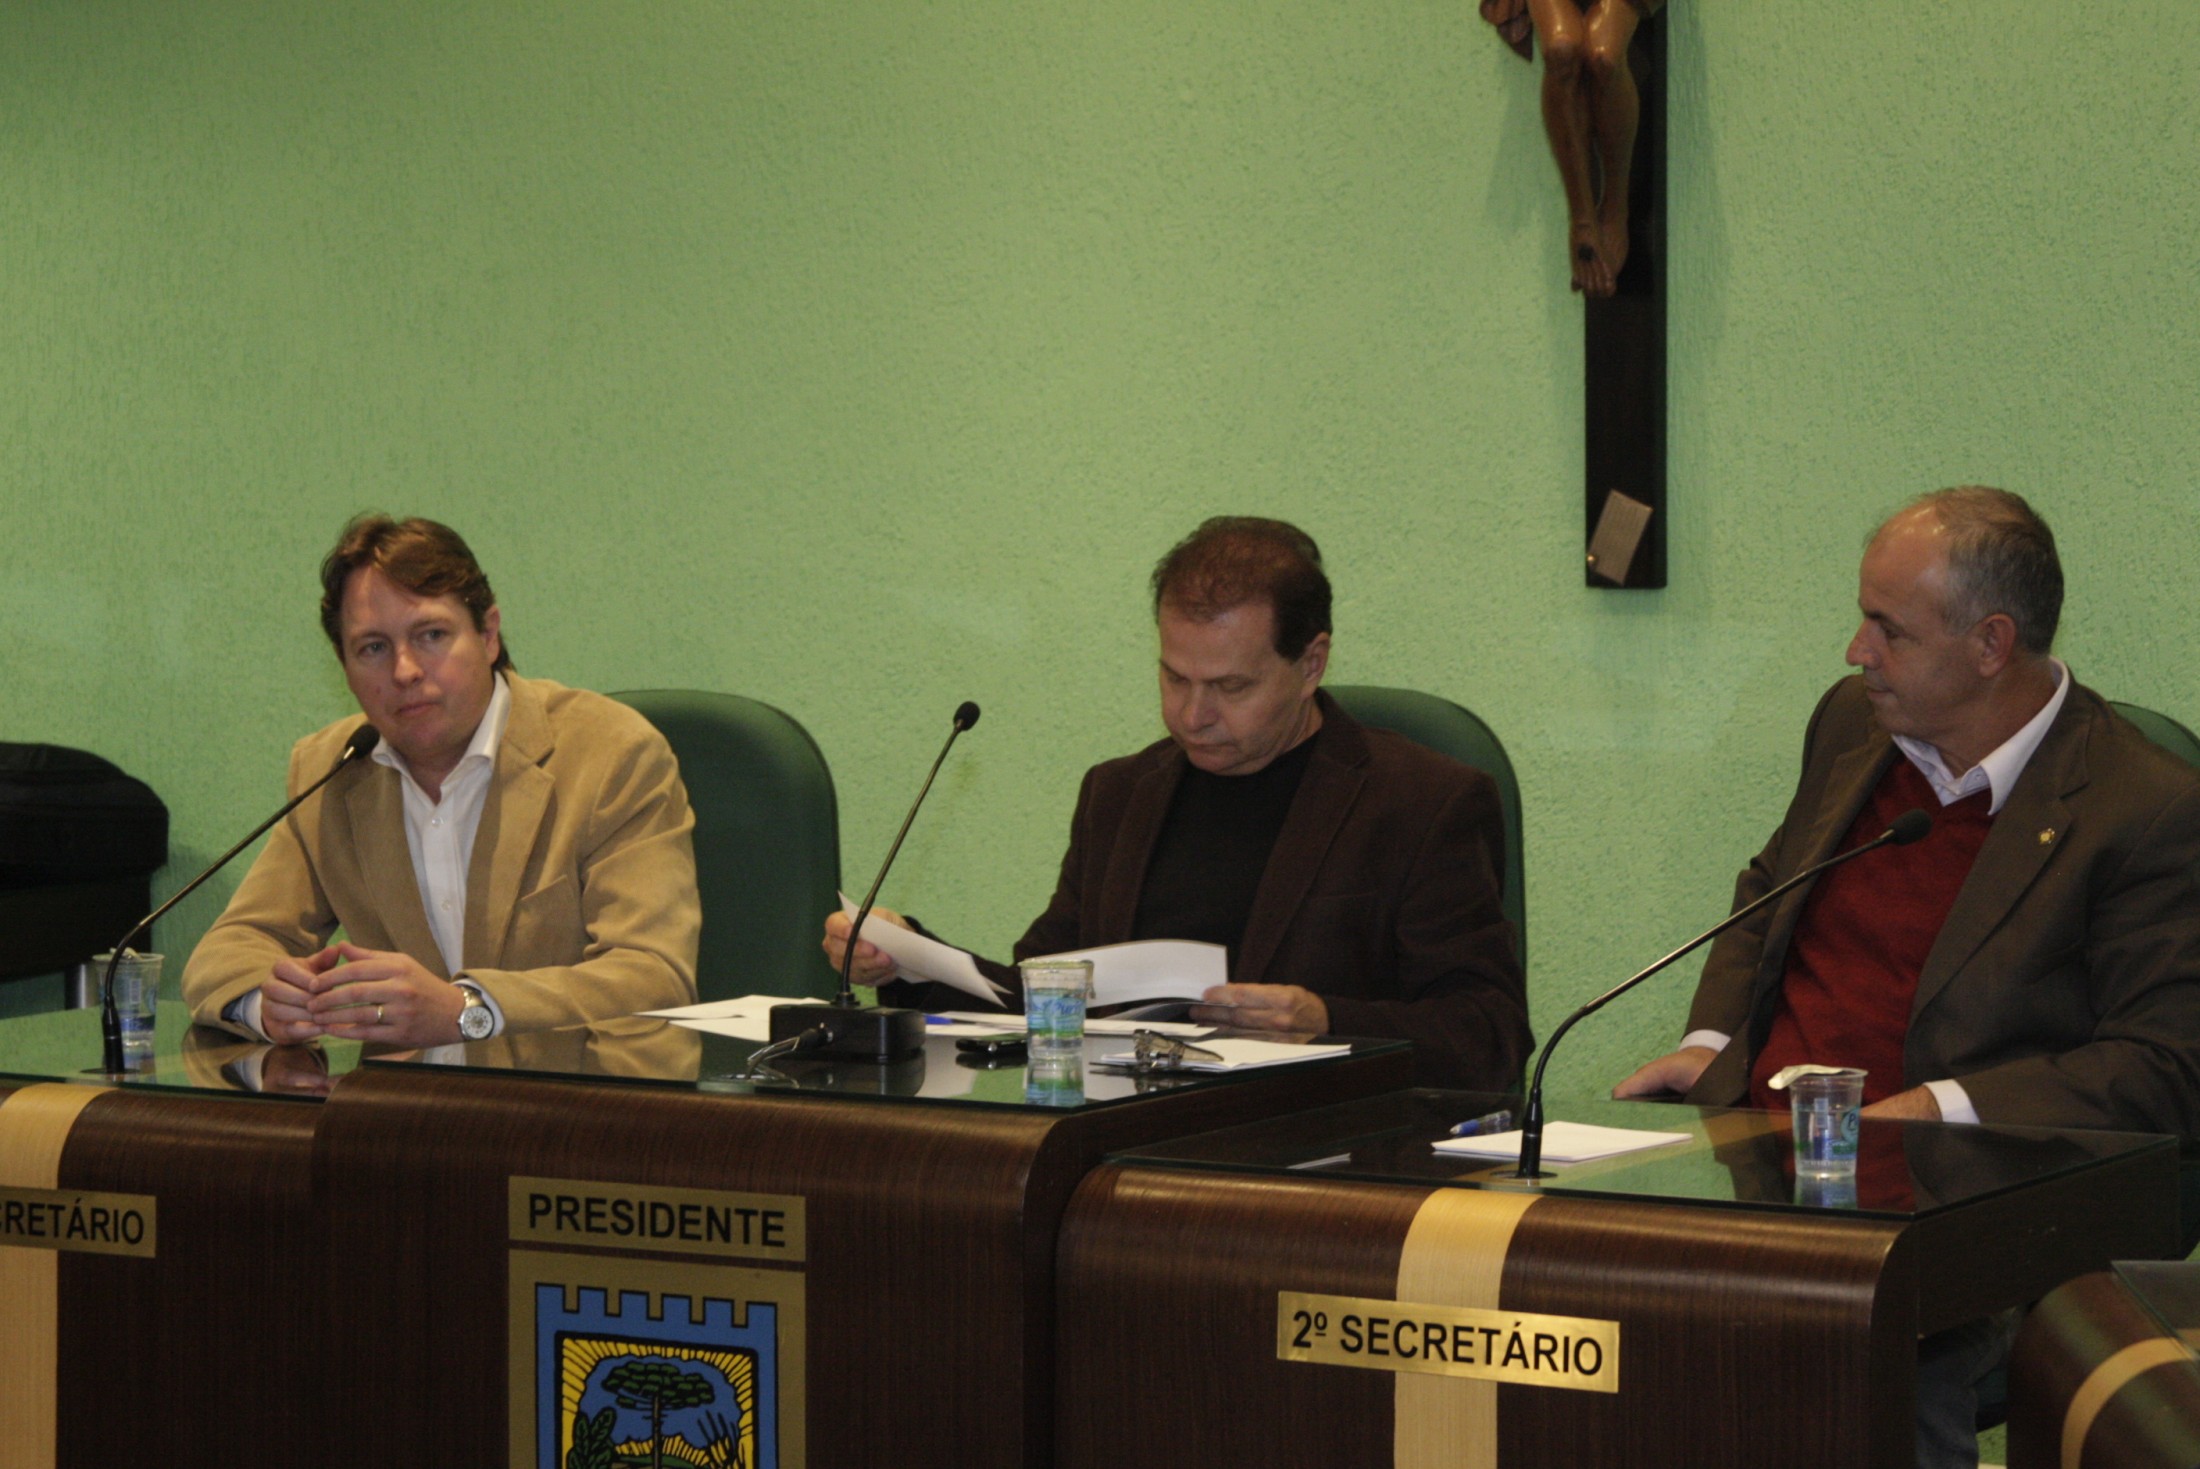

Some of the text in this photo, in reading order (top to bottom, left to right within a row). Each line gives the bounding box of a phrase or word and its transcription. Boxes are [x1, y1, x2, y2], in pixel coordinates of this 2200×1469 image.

[0, 1197, 144, 1245] RETÁRIO
[529, 1193, 785, 1247] PRESIDENTE
[1292, 1310, 1603, 1376] 2º SECRETÁRIO
